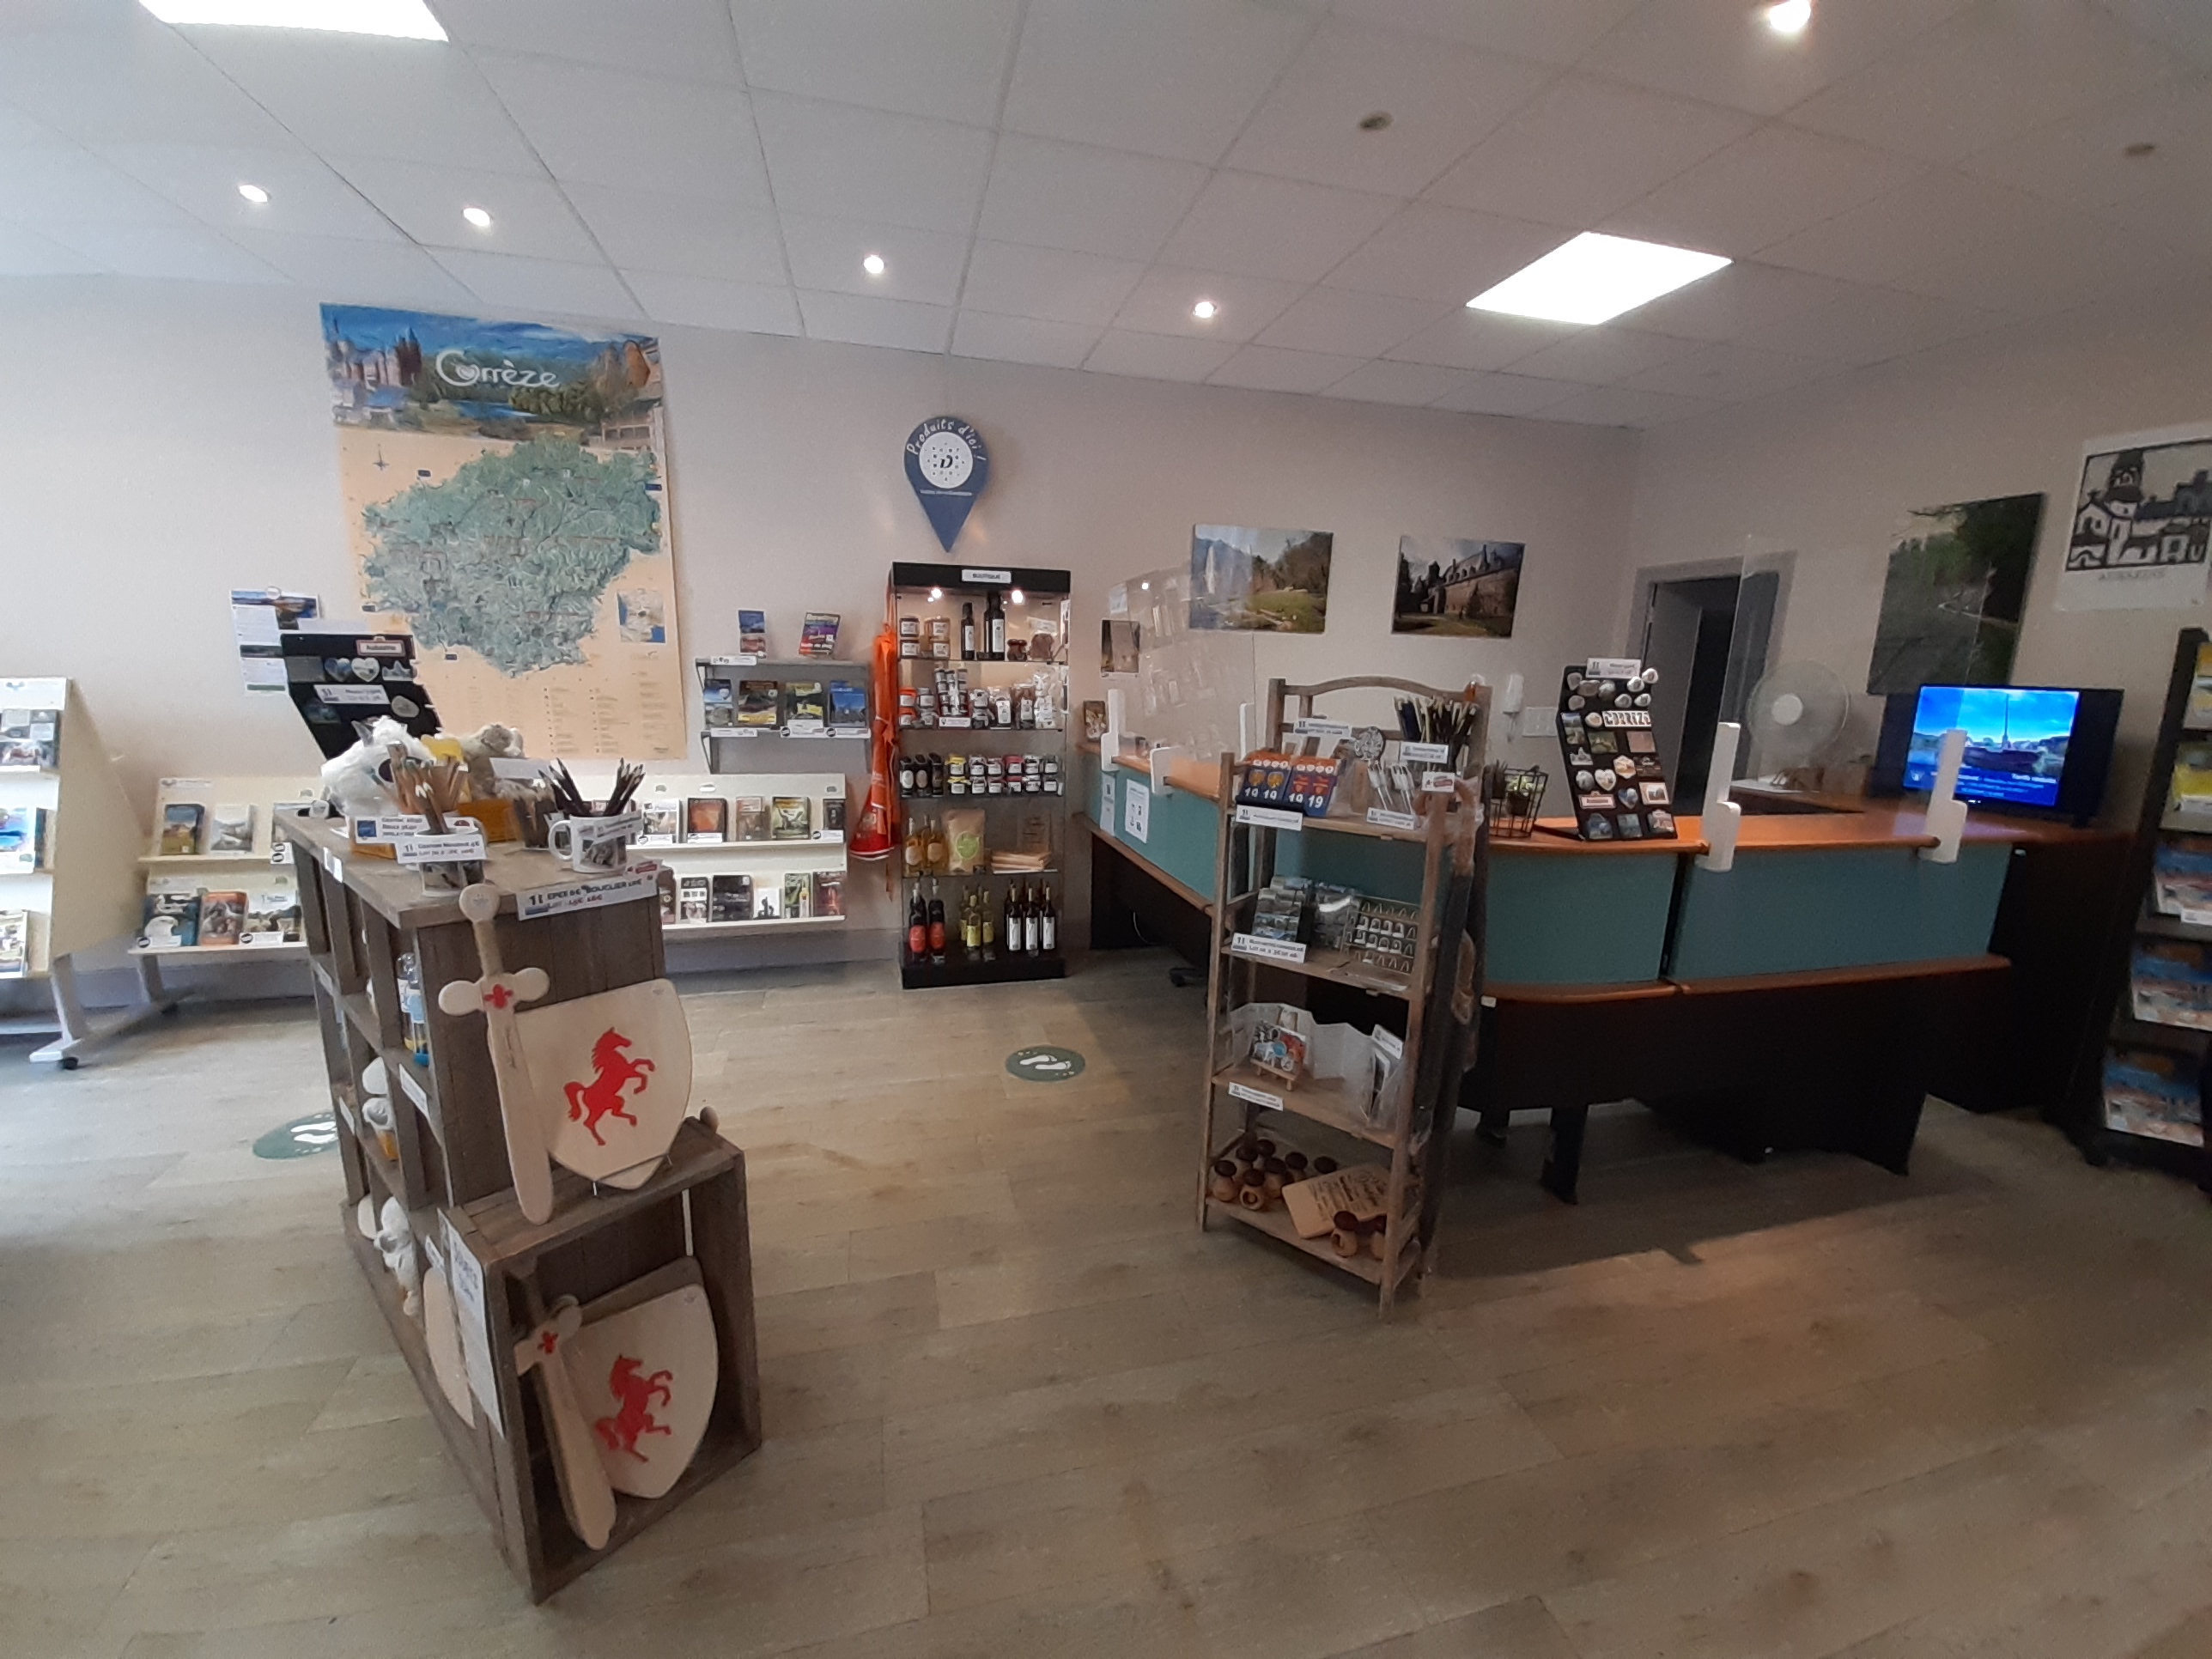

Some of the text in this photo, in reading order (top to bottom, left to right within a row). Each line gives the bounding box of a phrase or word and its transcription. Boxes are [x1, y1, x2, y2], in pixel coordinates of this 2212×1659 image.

[435, 349, 561, 387] Corrèze
[906, 418, 955, 455] Produits
[1308, 794, 1324, 808] 19
